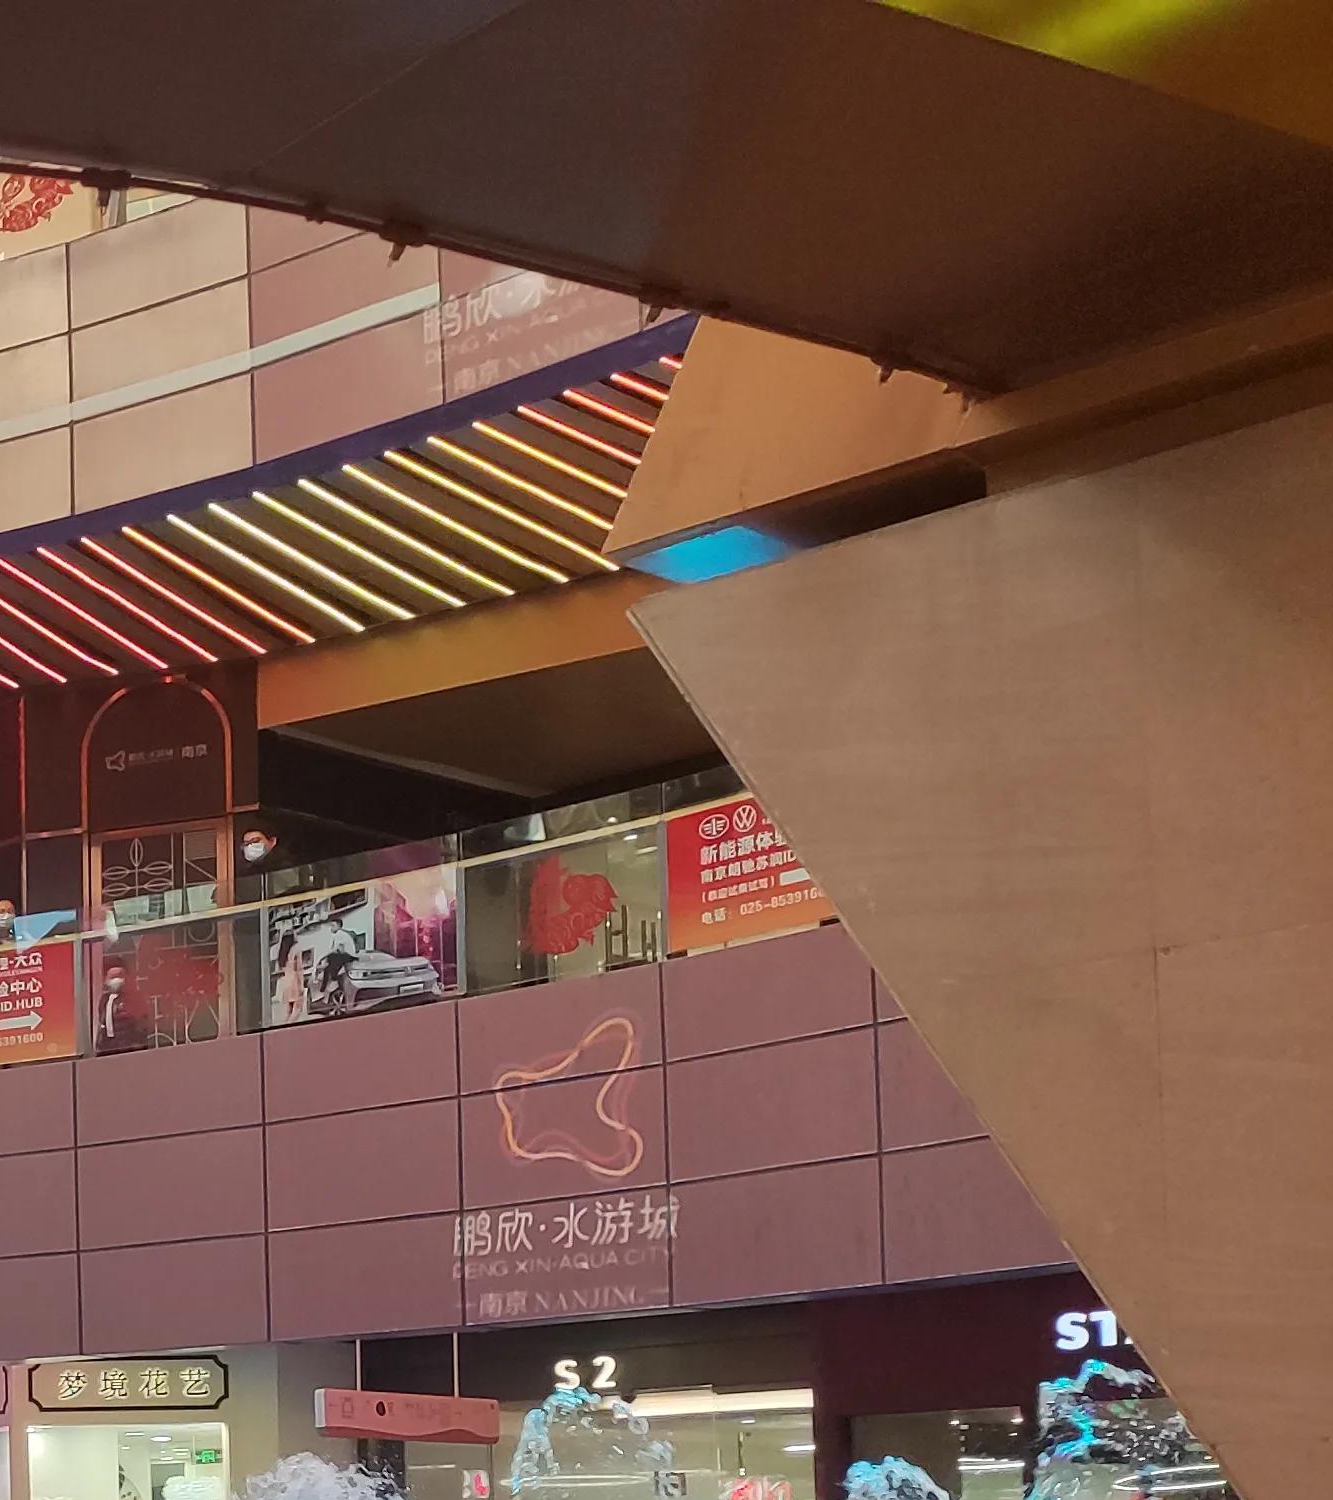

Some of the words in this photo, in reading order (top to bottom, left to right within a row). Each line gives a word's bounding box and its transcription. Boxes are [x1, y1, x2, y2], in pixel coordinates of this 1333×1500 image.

[453, 1195, 681, 1257] 鹏欣·水游城
[1055, 1310, 1134, 1351] ST
[58, 1368, 211, 1400] 梦境花艺
